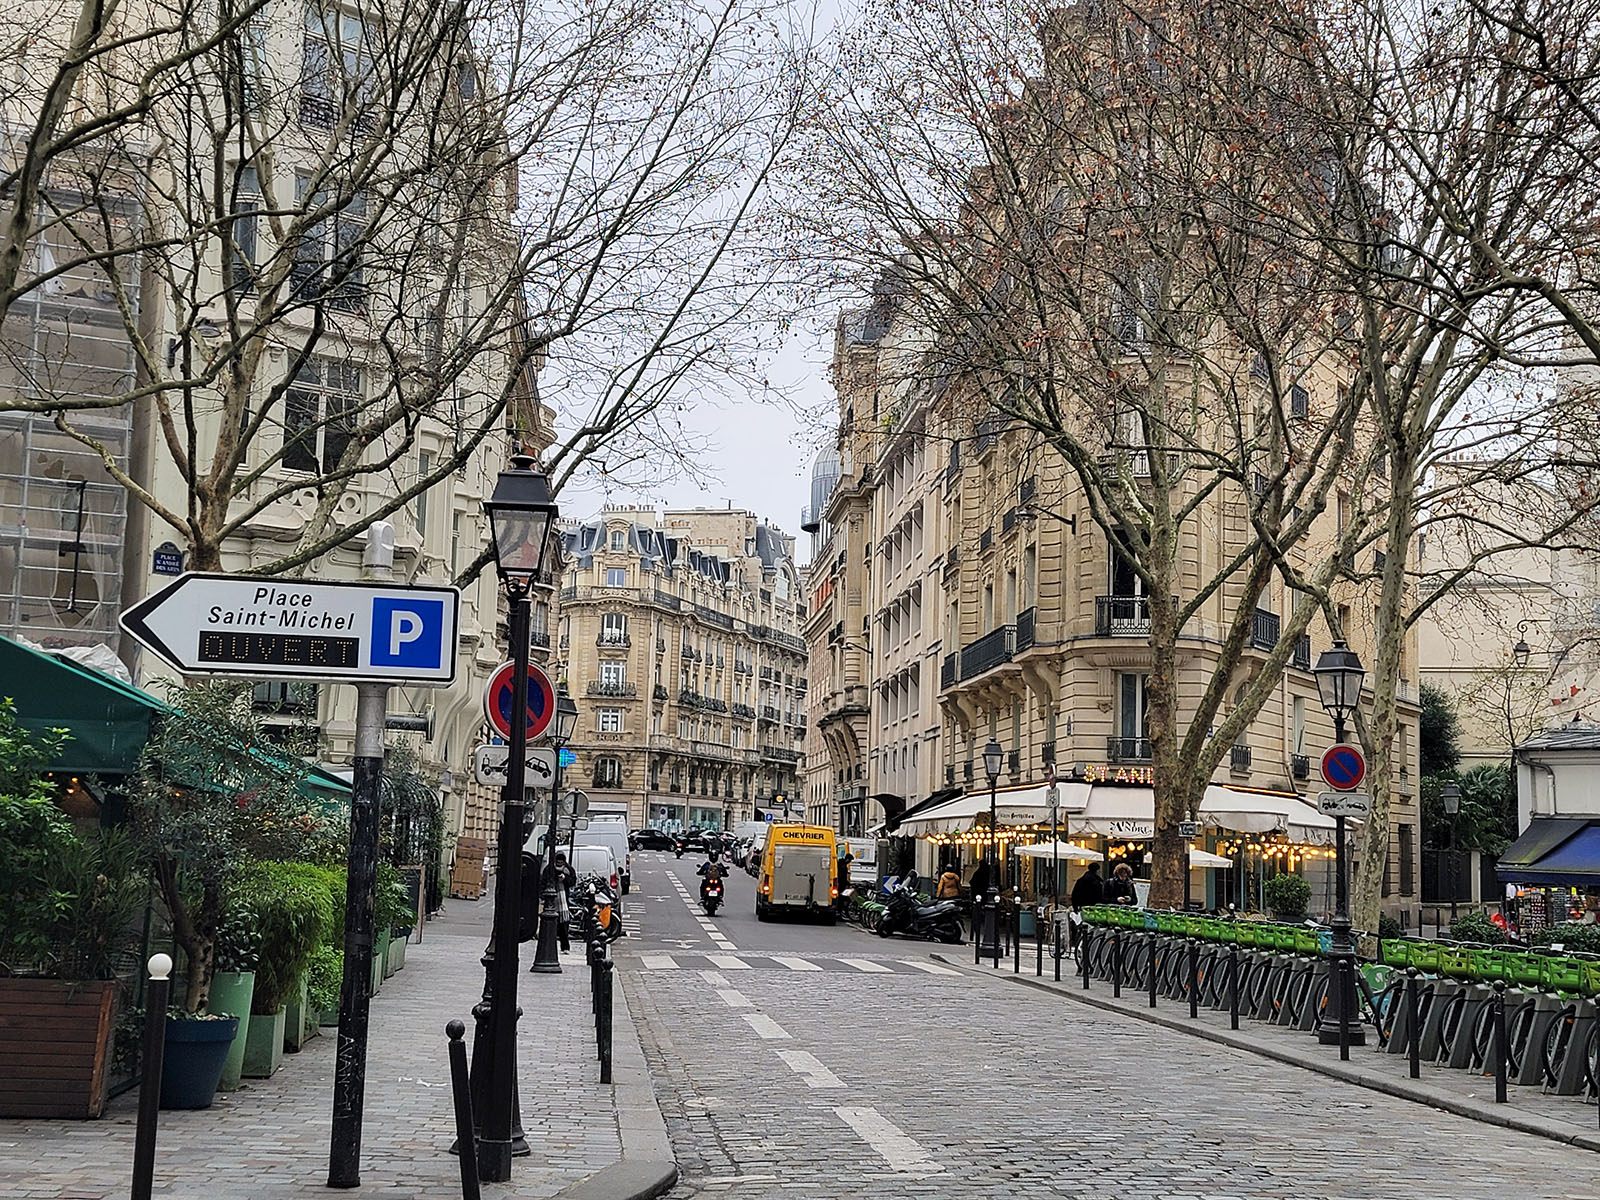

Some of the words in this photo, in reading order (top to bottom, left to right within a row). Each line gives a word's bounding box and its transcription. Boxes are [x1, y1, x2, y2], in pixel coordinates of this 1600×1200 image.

[254, 587, 312, 607] Place
[208, 606, 355, 630] Saint-Michel
[390, 610, 423, 655] P
[205, 635, 353, 664] OUVERT
[1083, 764, 1110, 783] ST
[783, 831, 824, 840] CHEVRIER
